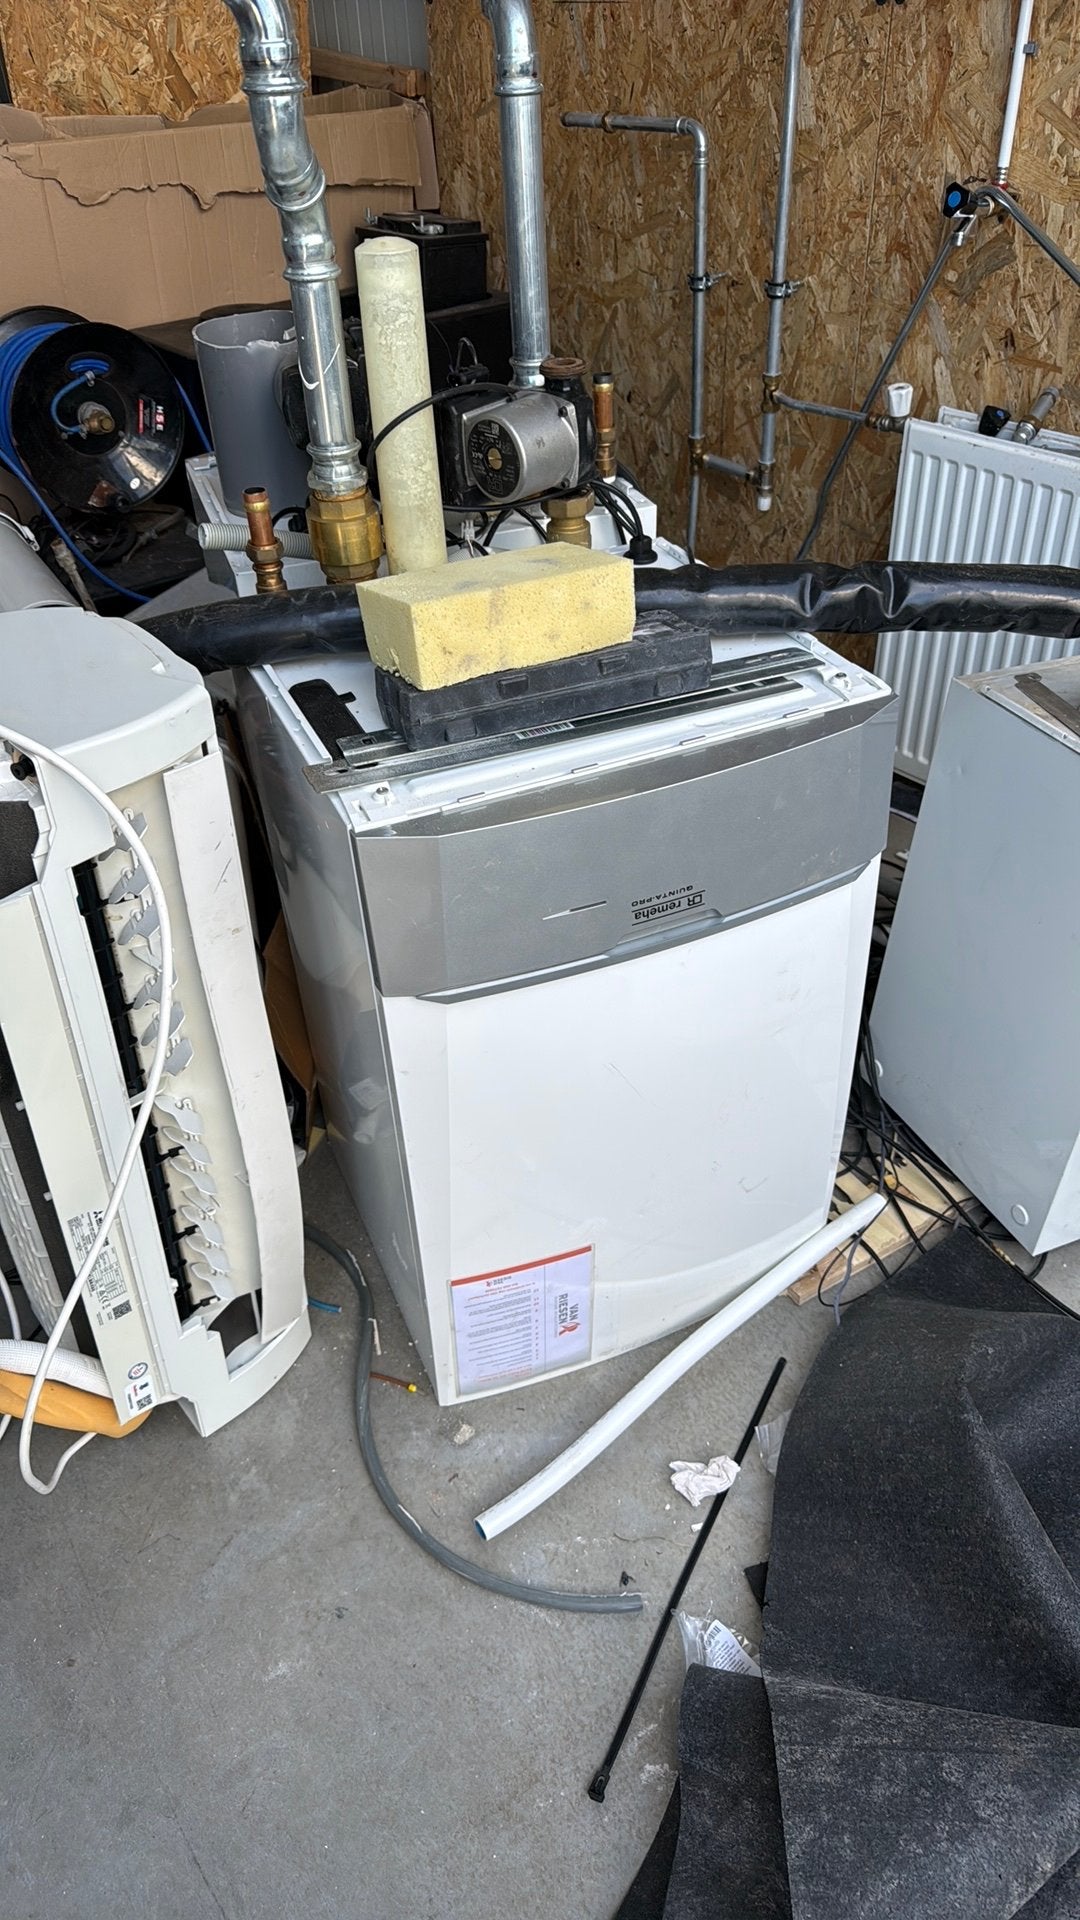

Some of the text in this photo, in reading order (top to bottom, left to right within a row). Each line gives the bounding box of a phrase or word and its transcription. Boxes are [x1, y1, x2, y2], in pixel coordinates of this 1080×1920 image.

[634, 899, 682, 920] remeha
[558, 1293, 568, 1325] RIESEN
[569, 1303, 578, 1321] VAN
